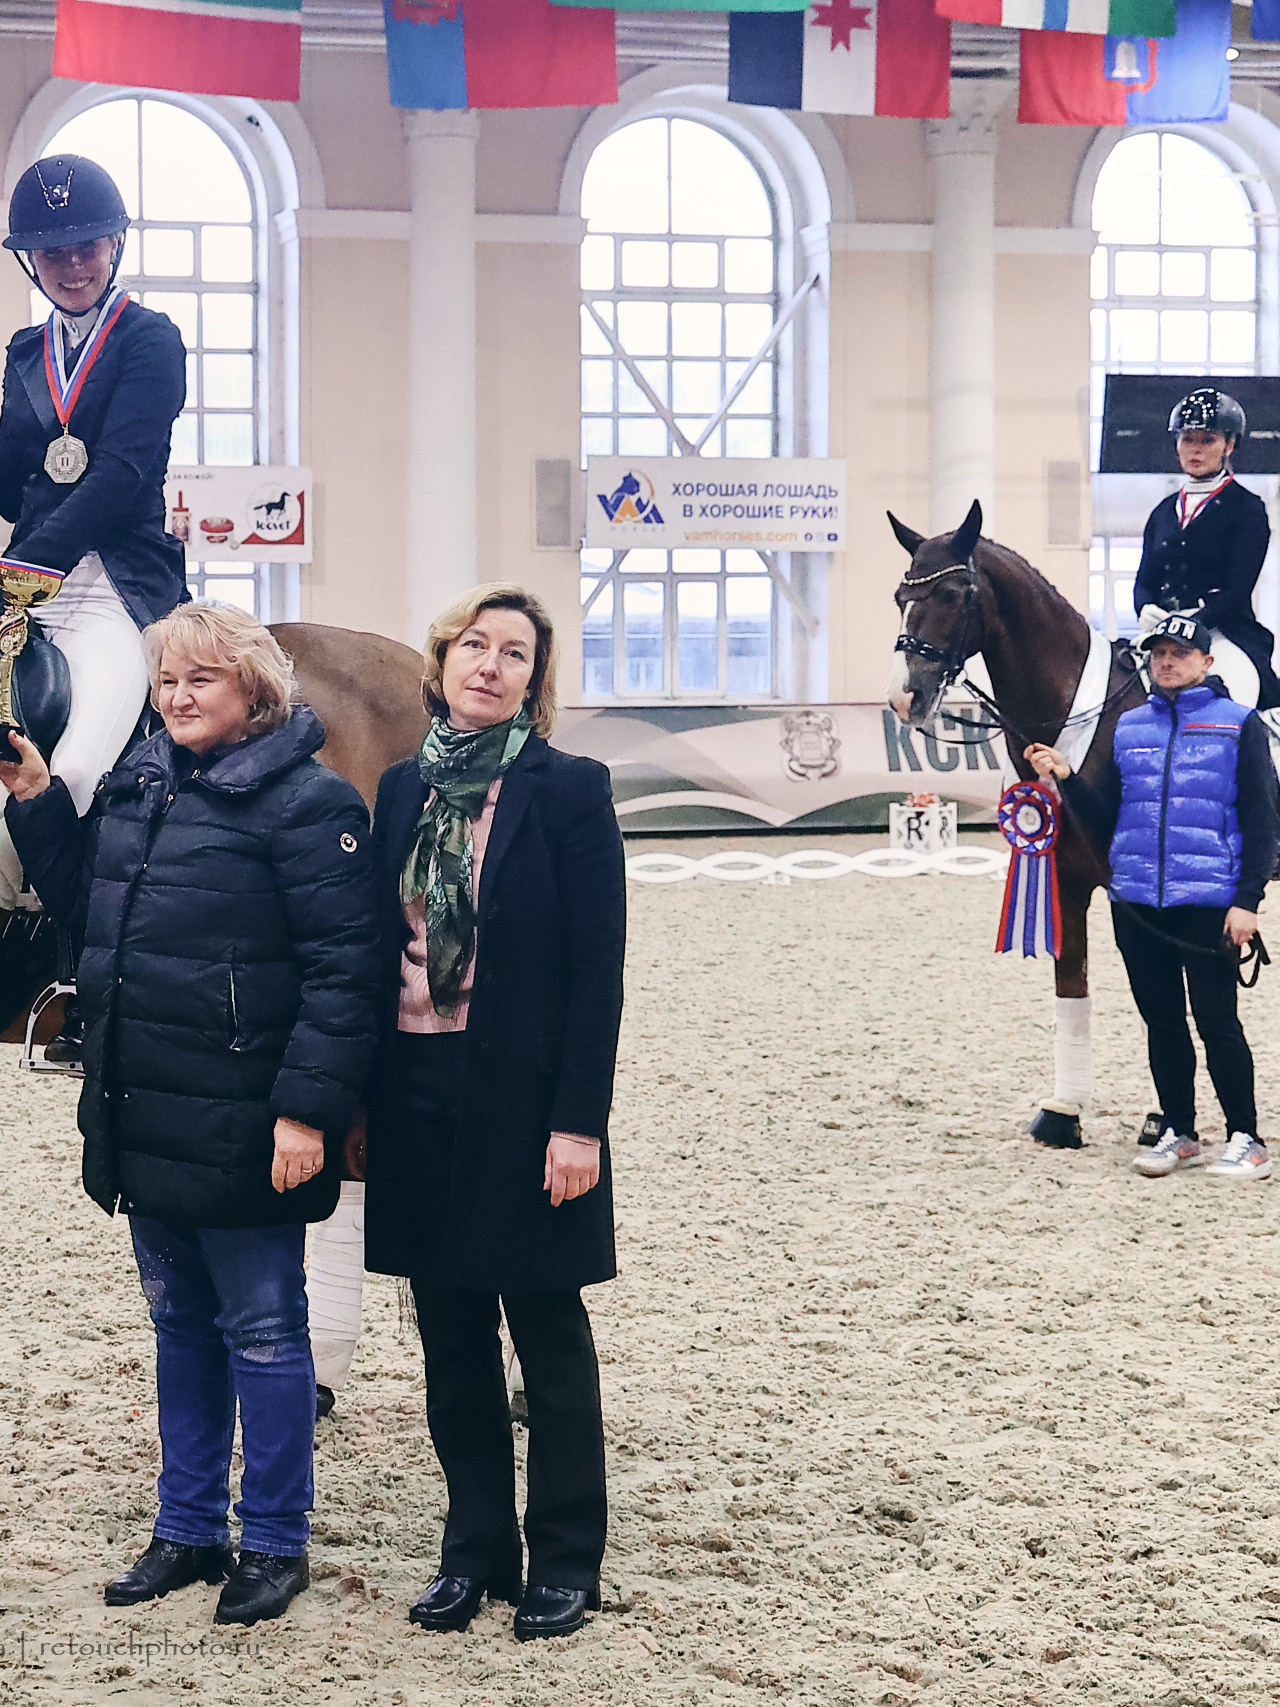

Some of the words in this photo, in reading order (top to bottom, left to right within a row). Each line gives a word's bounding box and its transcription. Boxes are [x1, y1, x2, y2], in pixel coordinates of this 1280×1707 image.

[671, 482, 758, 497] ХОРОШАЯ
[763, 483, 839, 499] ЛОШАДЬ
[683, 504, 693, 518] В
[699, 504, 784, 519] ХОРОШИЕ
[790, 505, 839, 519] РУКИ!
[684, 529, 797, 542] vamhorses.com
